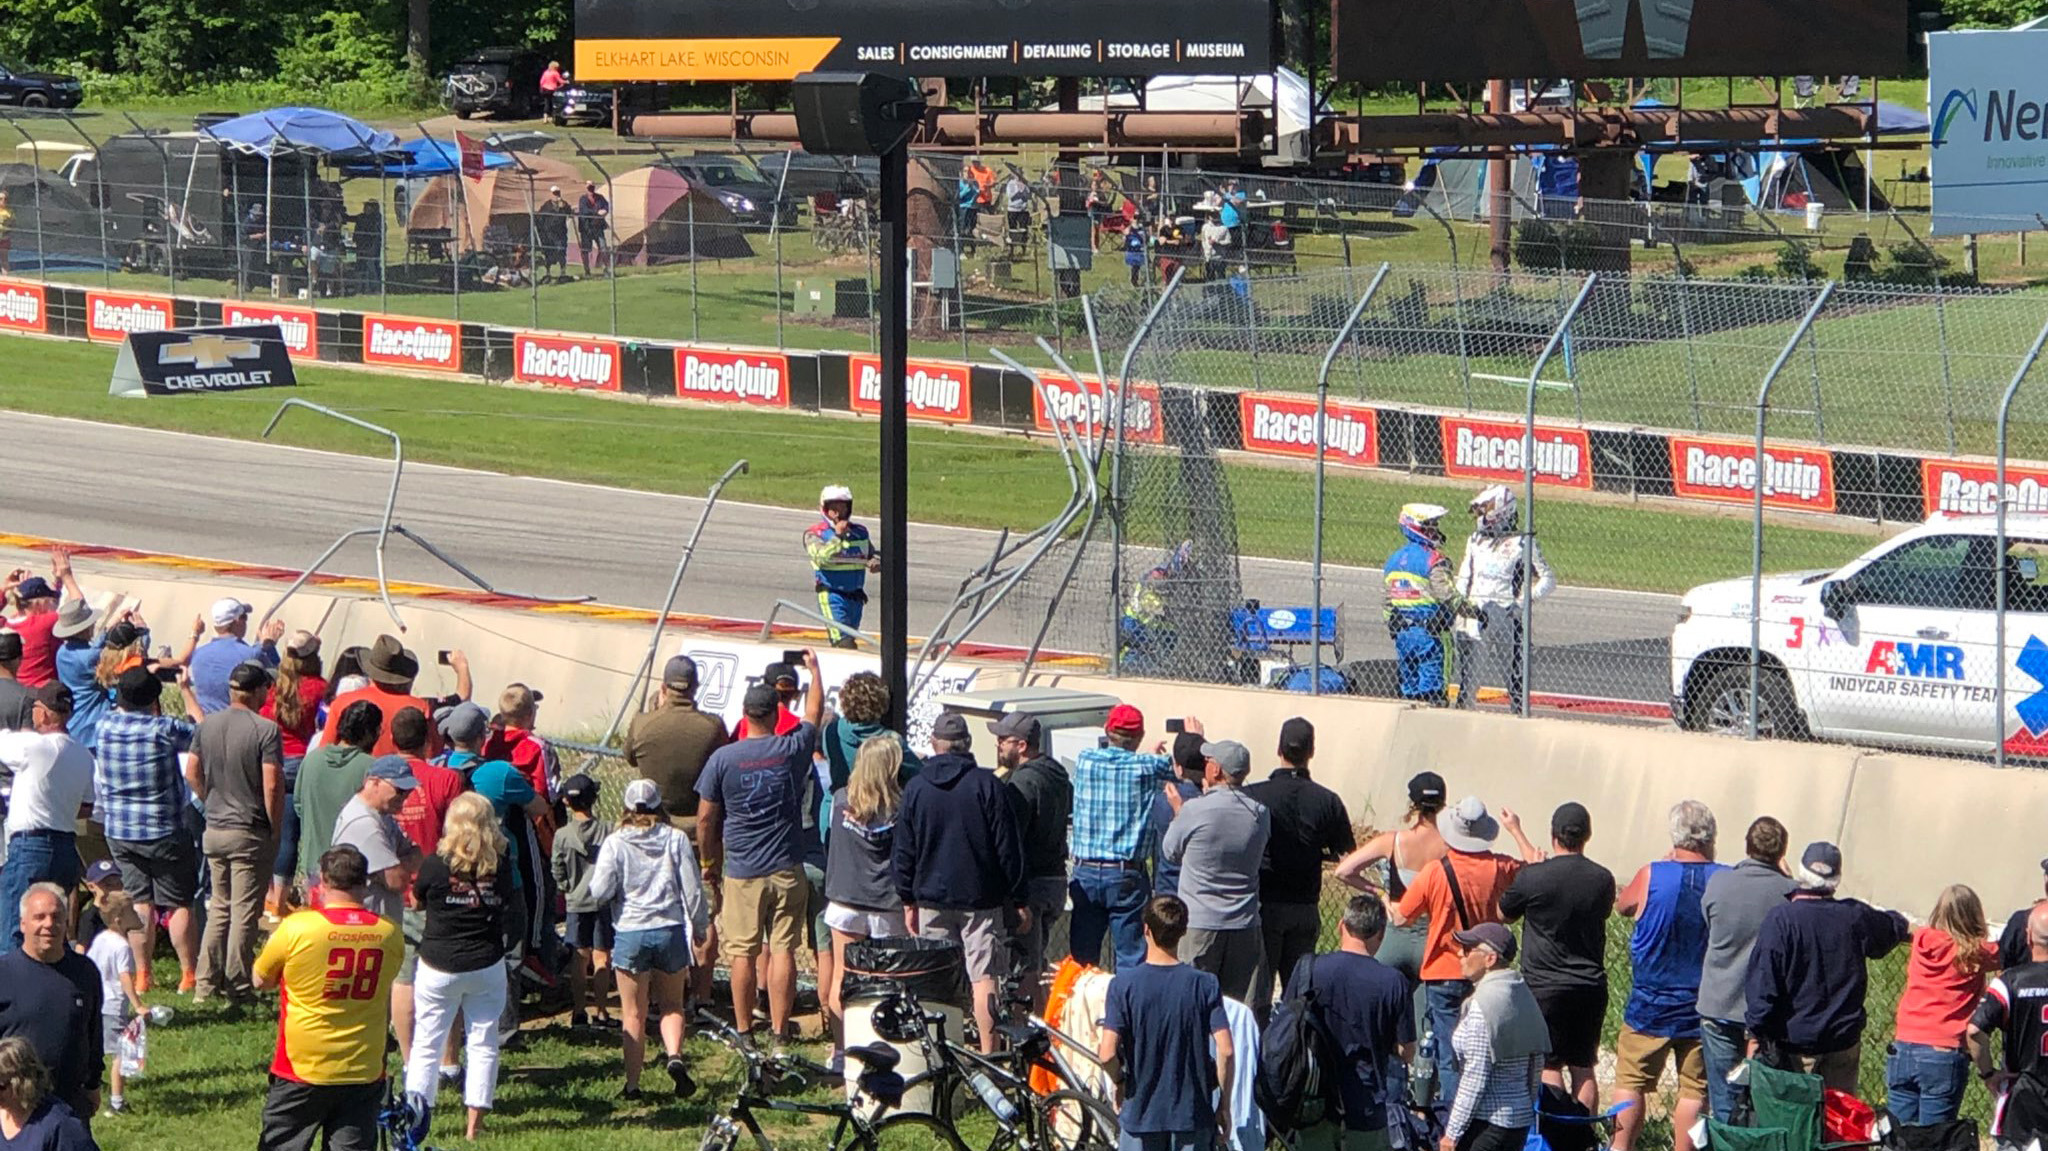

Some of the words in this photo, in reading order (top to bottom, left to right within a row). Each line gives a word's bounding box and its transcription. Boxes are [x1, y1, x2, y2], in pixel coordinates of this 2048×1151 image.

[595, 51, 656, 66] ELKHART
[704, 51, 789, 66] WISCONSIN
[857, 46, 895, 60] SALES
[910, 45, 1008, 60] CONSIGNMENT
[1023, 44, 1092, 58] DETAILING
[1107, 43, 1170, 57] STORAGE
[1186, 43, 1244, 57] MUSEUM
[370, 323, 452, 362] RaceQuip
[522, 342, 612, 383] RaceQuip
[684, 355, 779, 399] RaceQuip
[165, 371, 272, 390] CHEVROLET
[1687, 447, 1821, 499] RaceQuip
[1786, 617, 1804, 649] 3
[1865, 640, 1965, 680] AMR
[1830, 676, 1897, 694] INDYCAR
[1900, 682, 1959, 699] SAFETY
[327, 931, 383, 944] Grosjean
[323, 947, 384, 1000] 28
